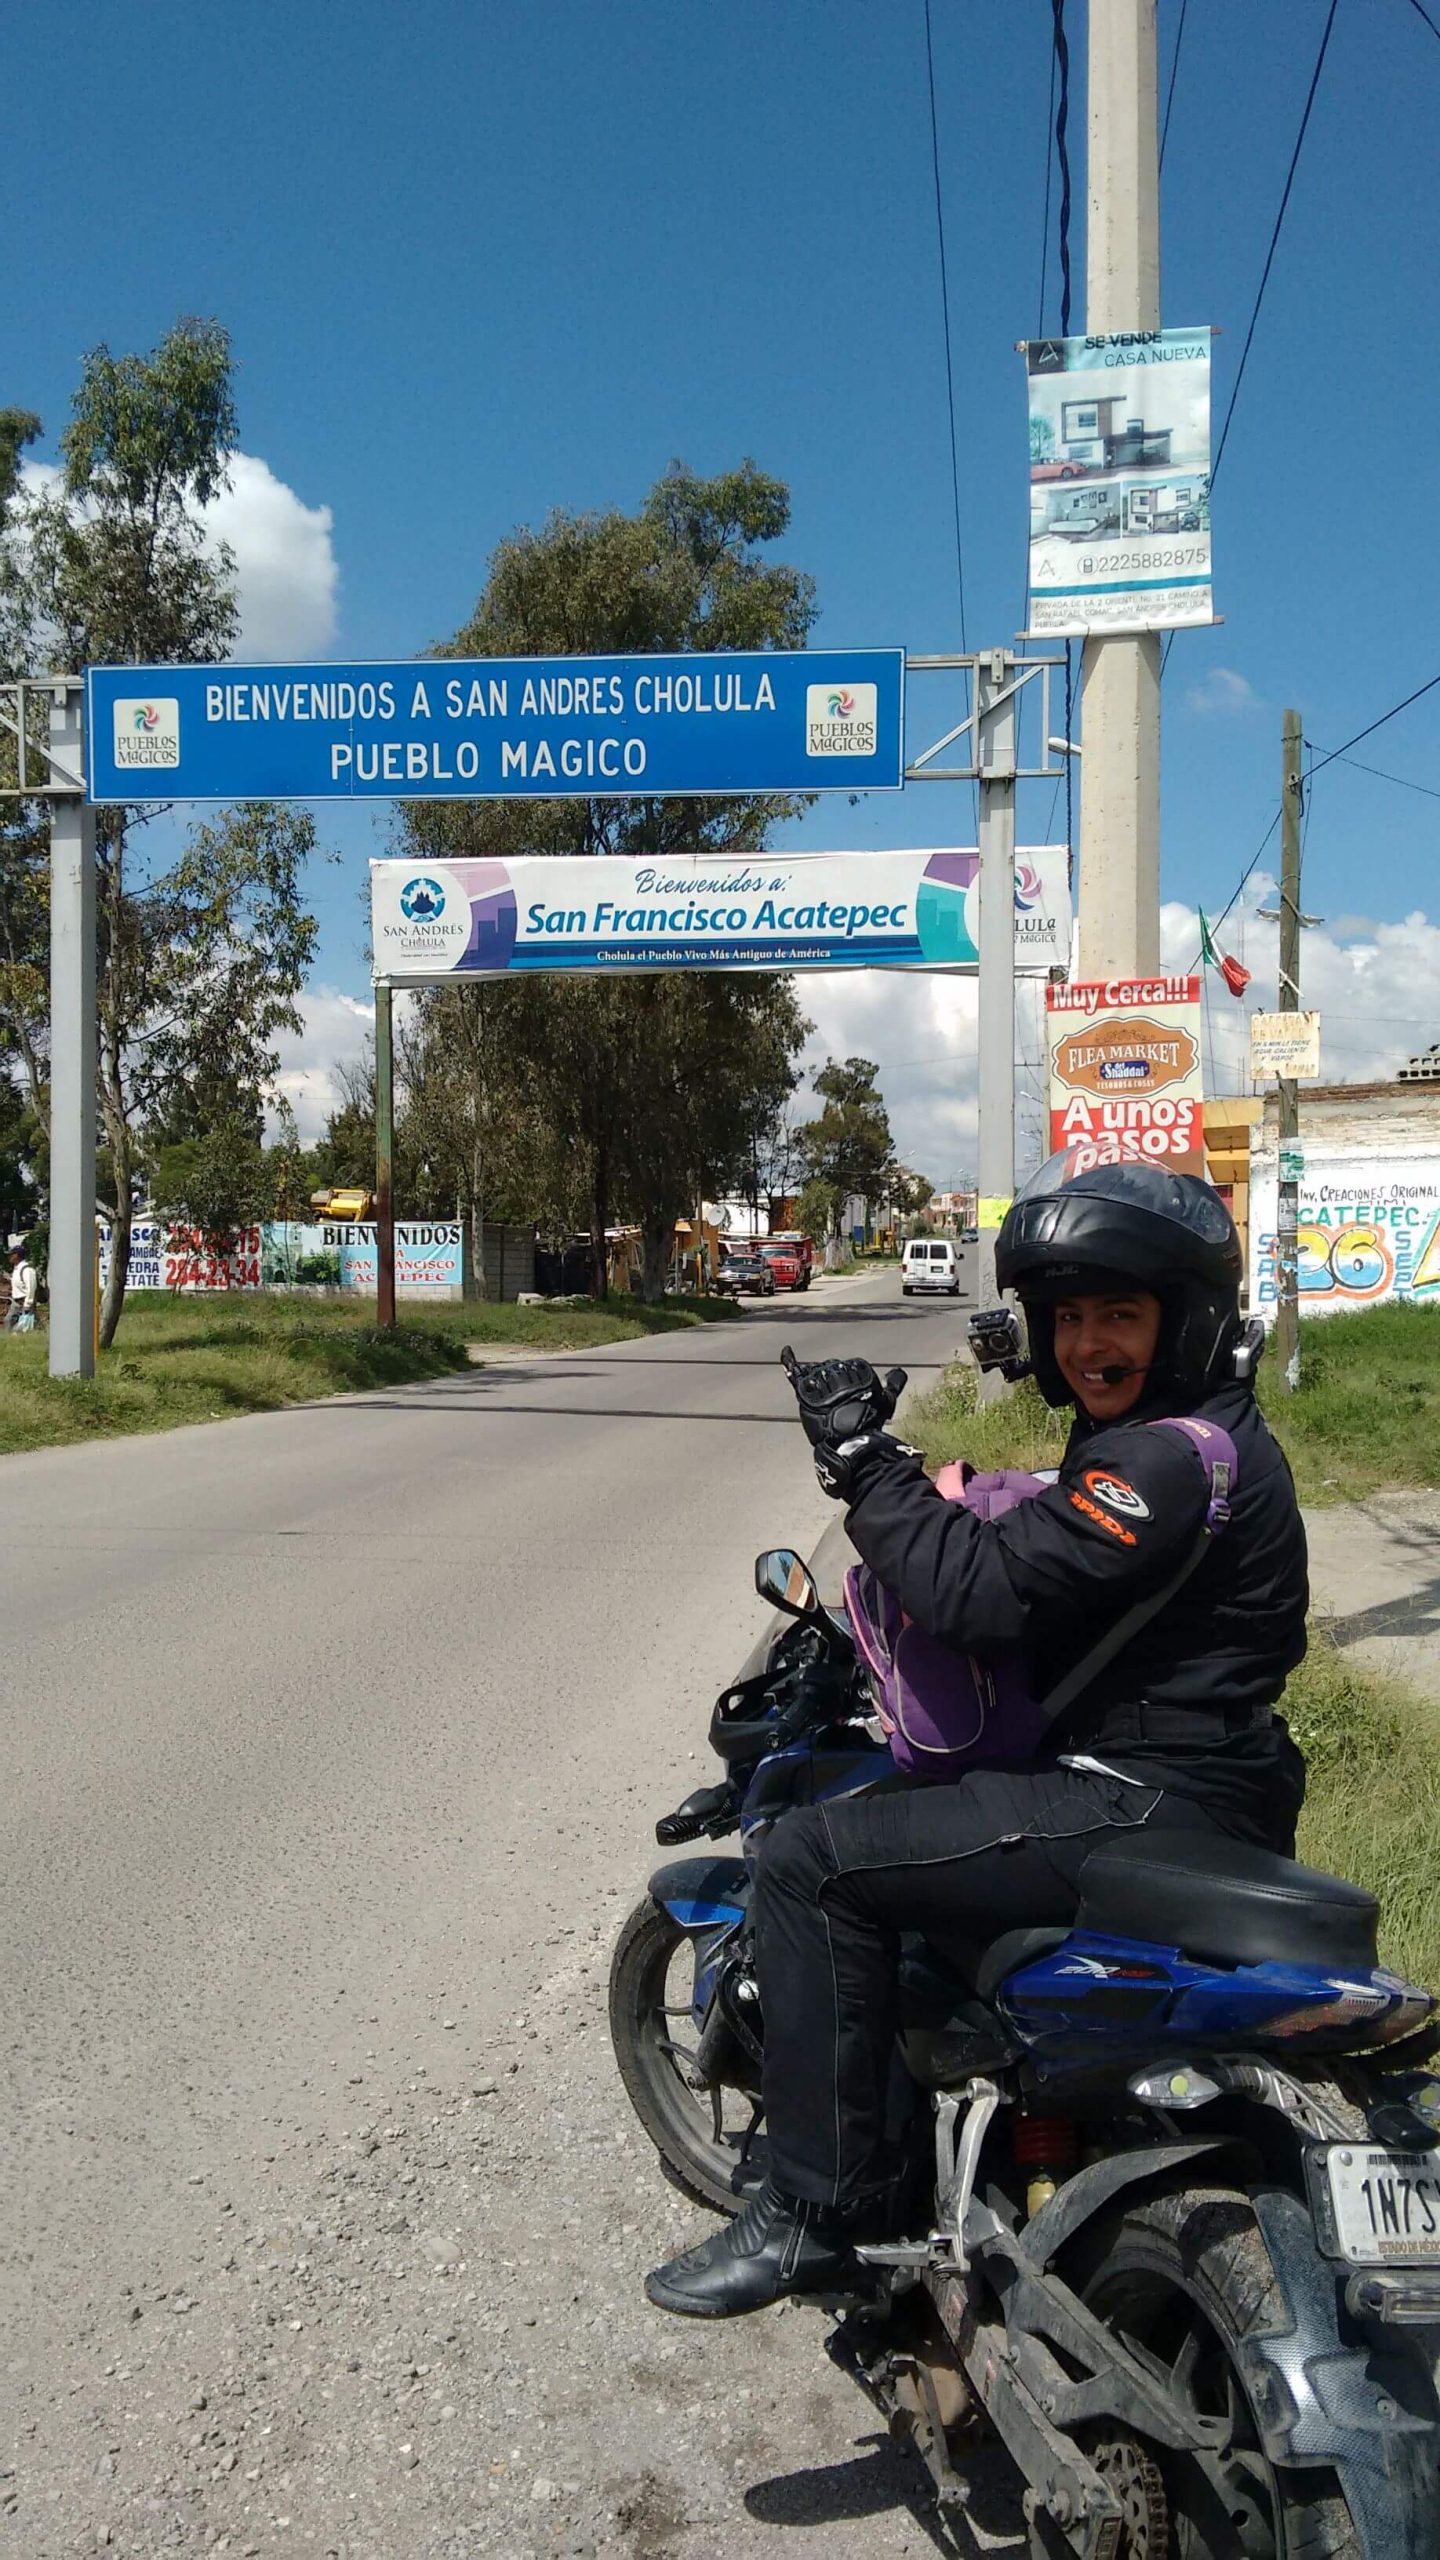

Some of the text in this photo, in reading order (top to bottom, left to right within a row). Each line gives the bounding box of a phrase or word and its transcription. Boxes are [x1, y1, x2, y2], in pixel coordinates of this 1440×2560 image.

[1084, 331, 1163, 350] SE VENDE
[1104, 346, 1207, 368] CASA NUEVA
[1098, 548, 1207, 573] 2225882875
[206, 673, 776, 722] BIENVENIDOS A SAN ANDRES CHOLULA
[331, 738, 647, 780] PUEBLO MAGICO
[635, 868, 792, 894] Bienvenidos a:
[525, 900, 907, 937] San Francisco Acatepec
[383, 925, 408, 937] SAN
[400, 936, 446, 948] CHOLULA
[596, 947, 831, 962] Cholula el Pueblo Vivo Más Antiguo de América
[1052, 975, 1189, 1015] Muy Cerca!!!
[1068, 1042, 1180, 1073] FLEA MARKET
[1062, 1096, 1194, 1131] A unos
[1320, 1184, 1386, 1203] CREACIONES
[1297, 1205, 1427, 1226] CATEPEC.
[323, 1224, 461, 1246] BIENNIDOS
[344, 1260, 455, 1270] SAN ANCISCO
[1296, 1227, 1384, 1292] 26
[353, 1273, 446, 1282] ACEPEC
[1361, 2178, 1440, 2235] 1N7S
